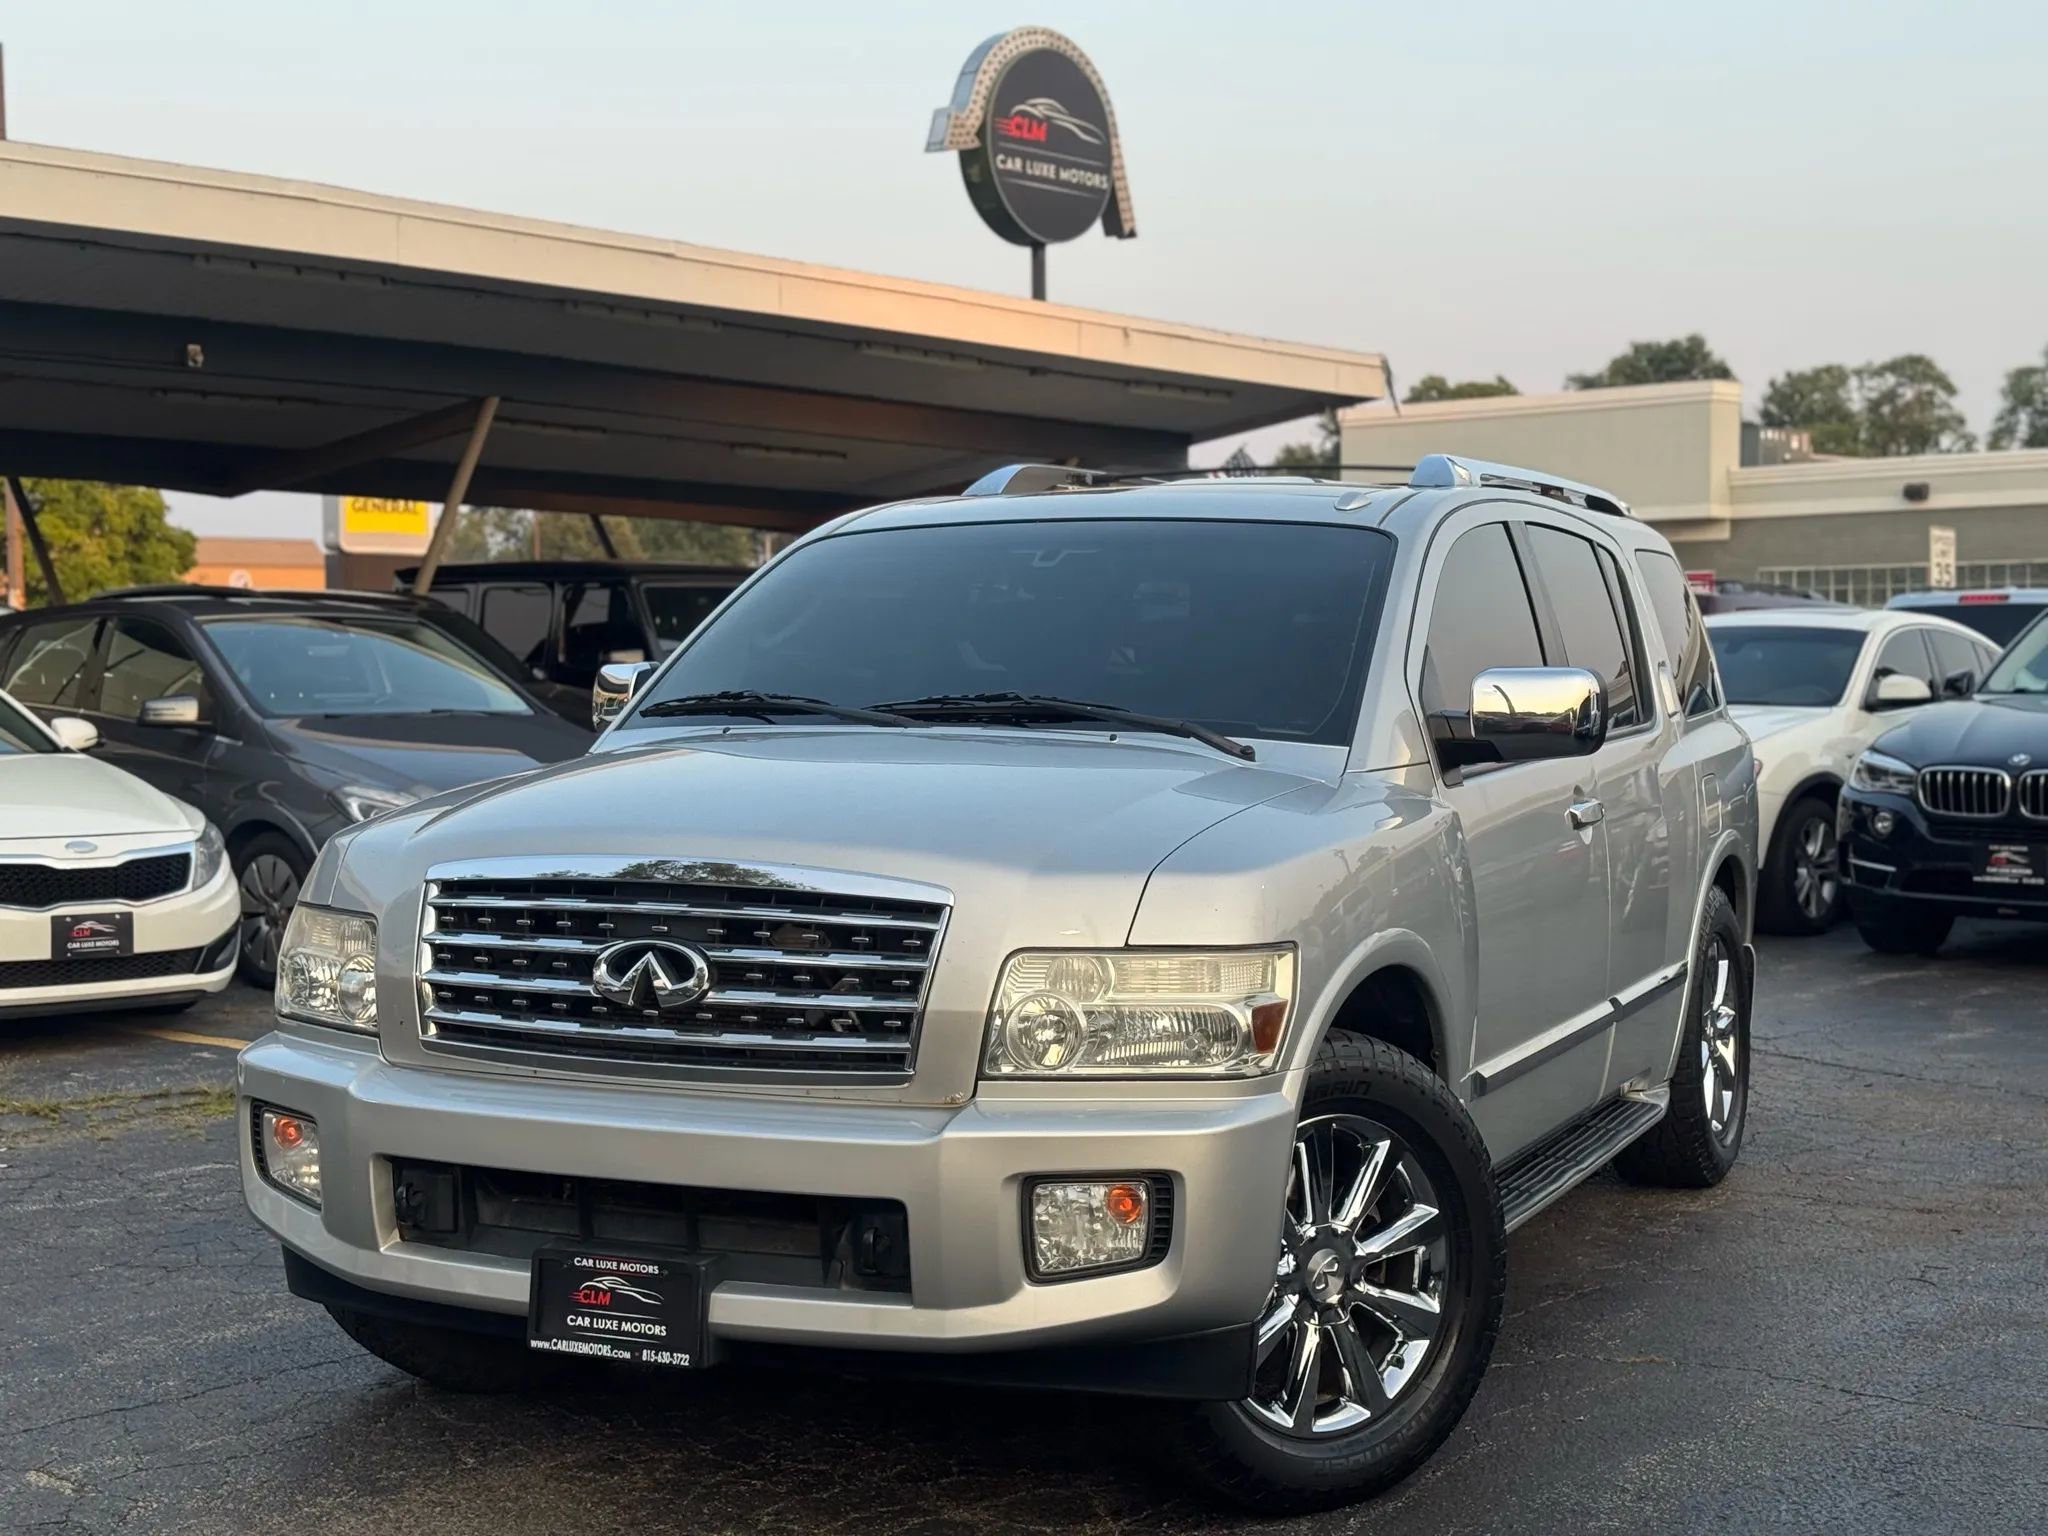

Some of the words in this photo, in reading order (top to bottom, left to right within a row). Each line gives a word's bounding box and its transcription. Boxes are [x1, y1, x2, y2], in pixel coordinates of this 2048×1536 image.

[1007, 114, 1047, 143] CLM
[996, 153, 1023, 173] CAR
[1025, 159, 1057, 179] LUXE
[1059, 166, 1108, 190] MOTORS
[67, 941, 81, 949] CAR
[574, 1257, 594, 1268] CAR
[596, 1260, 618, 1270] LUXE
[619, 1262, 659, 1274] MOTORS
[580, 1289, 612, 1306] CLM
[566, 1315, 591, 1328] CAR
[593, 1318, 619, 1330] LUXE
[620, 1321, 667, 1337] MOTORS
[641, 1349, 690, 1367] 815-630-3722
